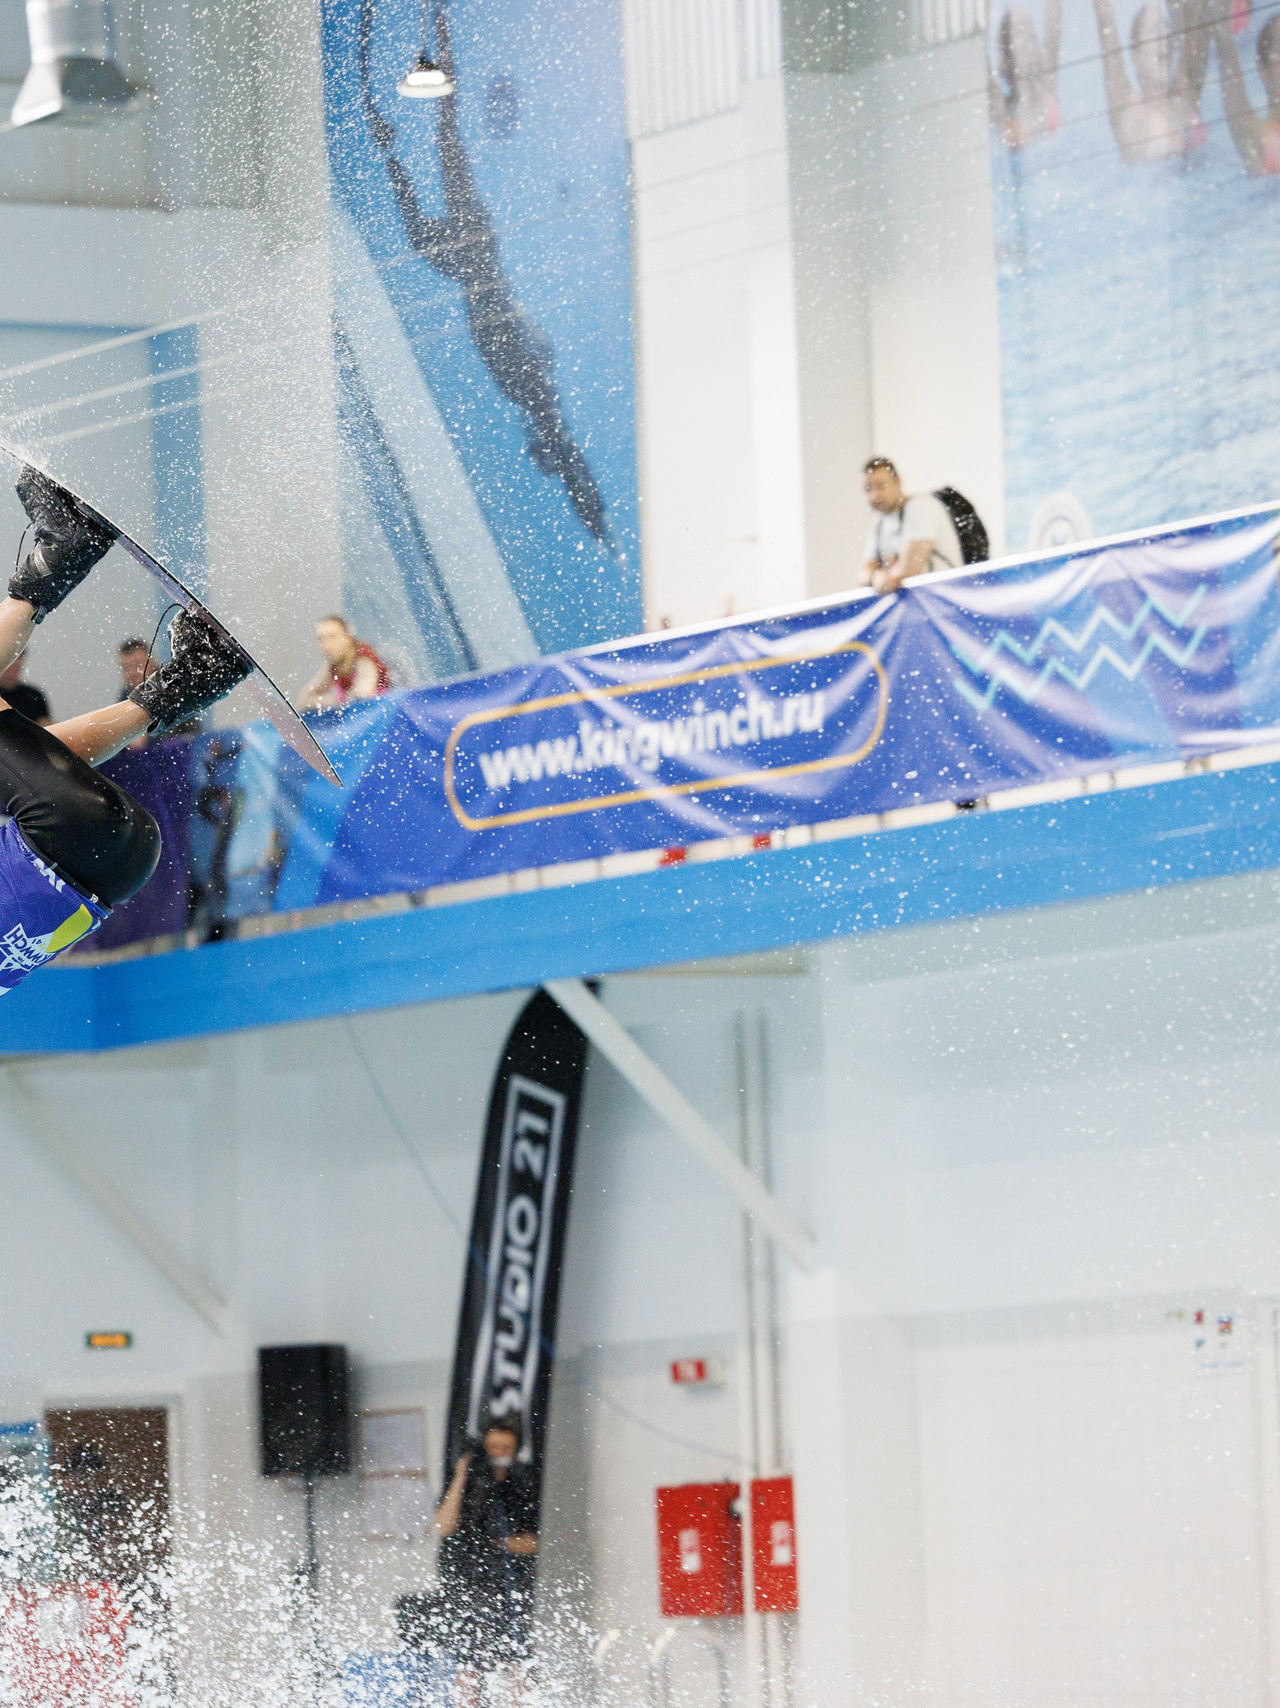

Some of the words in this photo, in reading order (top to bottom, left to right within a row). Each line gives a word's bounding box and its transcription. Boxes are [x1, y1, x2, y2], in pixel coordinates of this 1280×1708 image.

[479, 690, 825, 790] www.kingwinch.ru
[513, 1110, 551, 1182] 21
[490, 1193, 539, 1418] STUDIO
